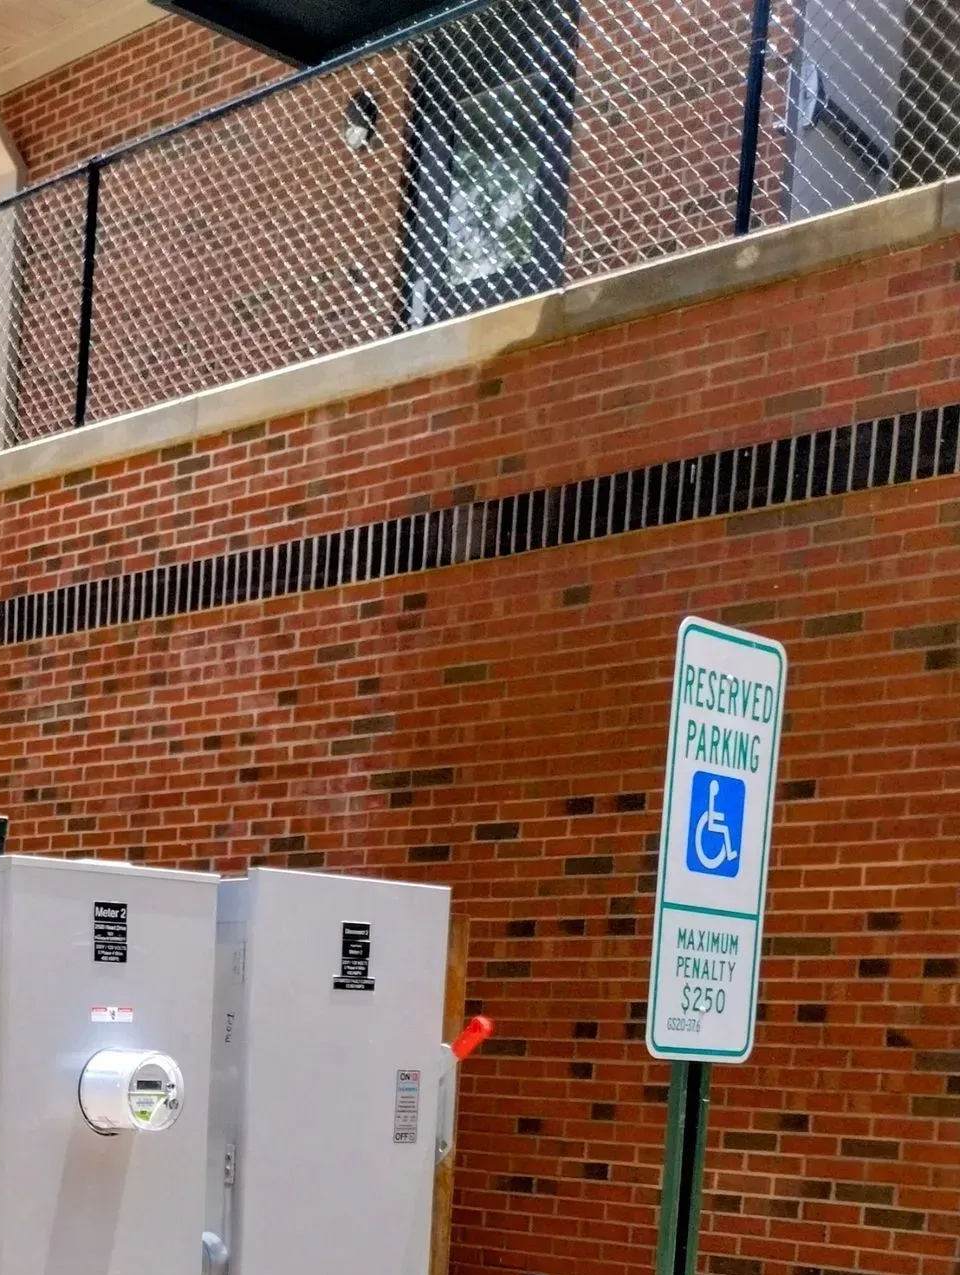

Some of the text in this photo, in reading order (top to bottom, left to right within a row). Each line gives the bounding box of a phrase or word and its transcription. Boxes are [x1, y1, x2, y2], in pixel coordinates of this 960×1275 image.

[683, 663, 774, 724] RESERVED
[685, 719, 761, 774] PARKING
[95, 906, 127, 919] Meter 2
[676, 927, 740, 956] MAXIMUM
[675, 956, 737, 983] PENALTY
[681, 982, 726, 1015] $250
[399, 1072, 411, 1081] ON
